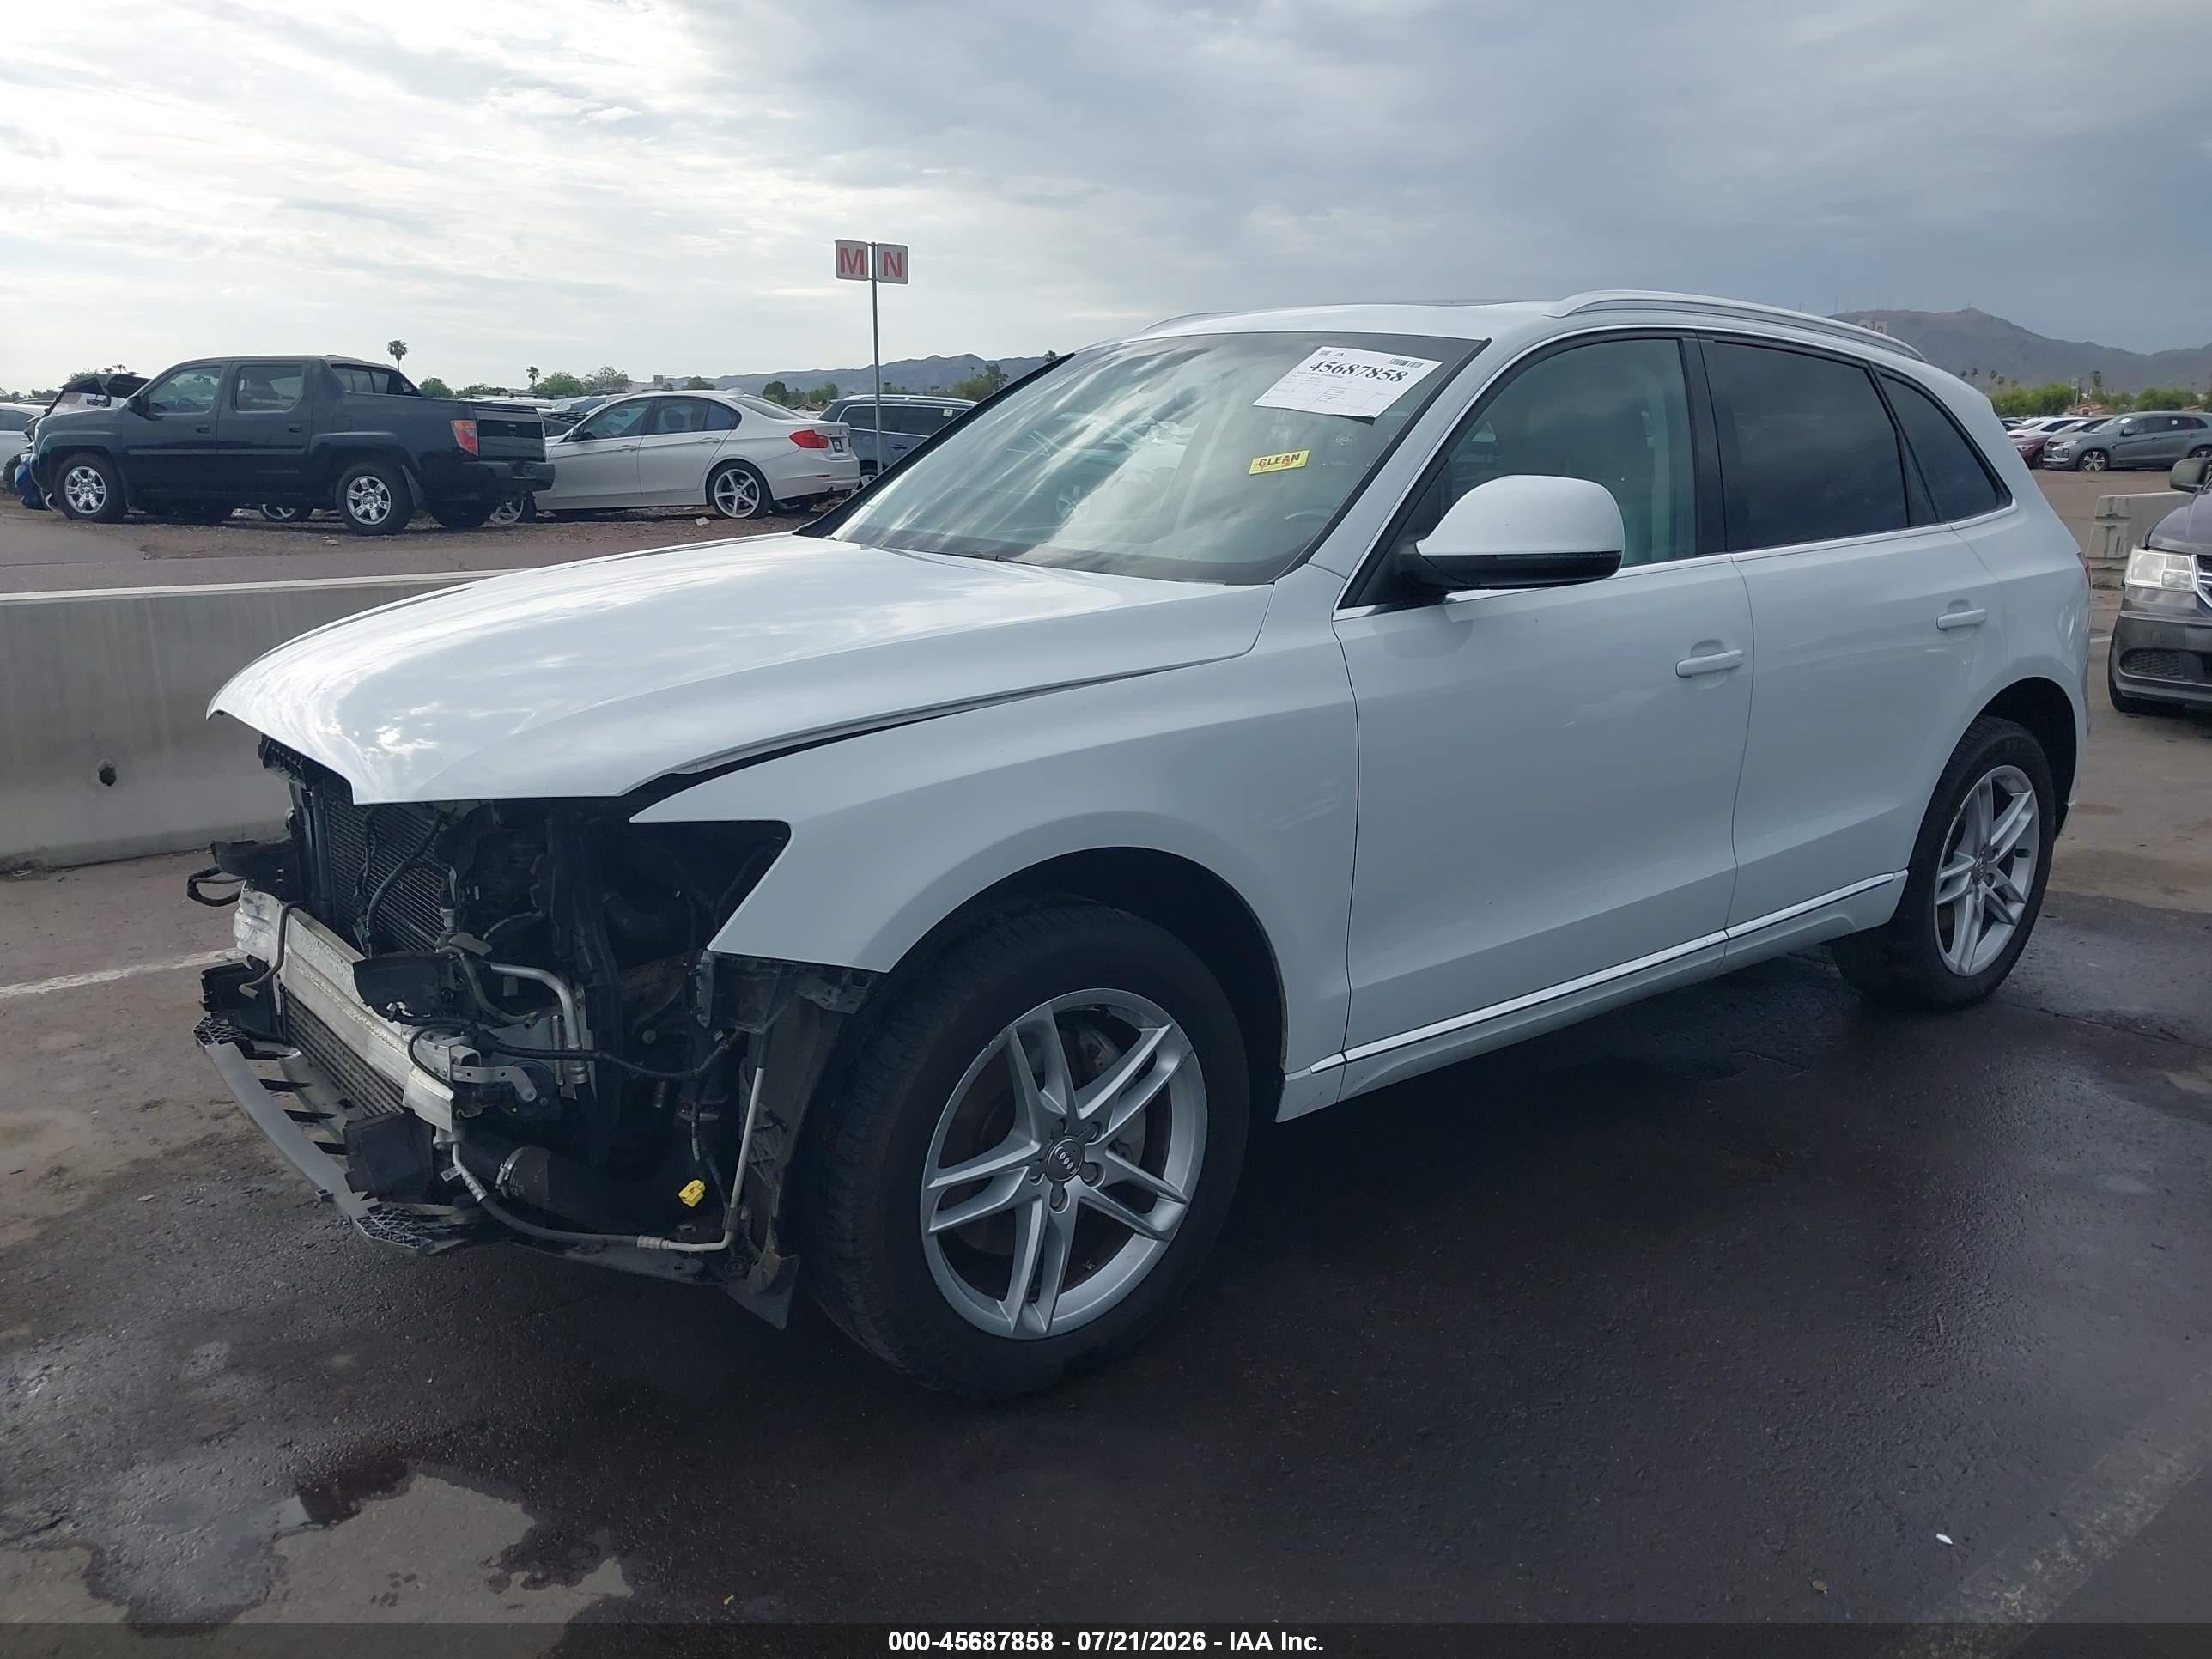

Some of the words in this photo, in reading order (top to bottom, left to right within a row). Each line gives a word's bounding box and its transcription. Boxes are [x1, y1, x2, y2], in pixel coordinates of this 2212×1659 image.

[840, 247, 865, 276] M
[883, 251, 902, 278] N
[1309, 360, 1409, 383] 45687858
[1259, 453, 1301, 468] CLEAN
